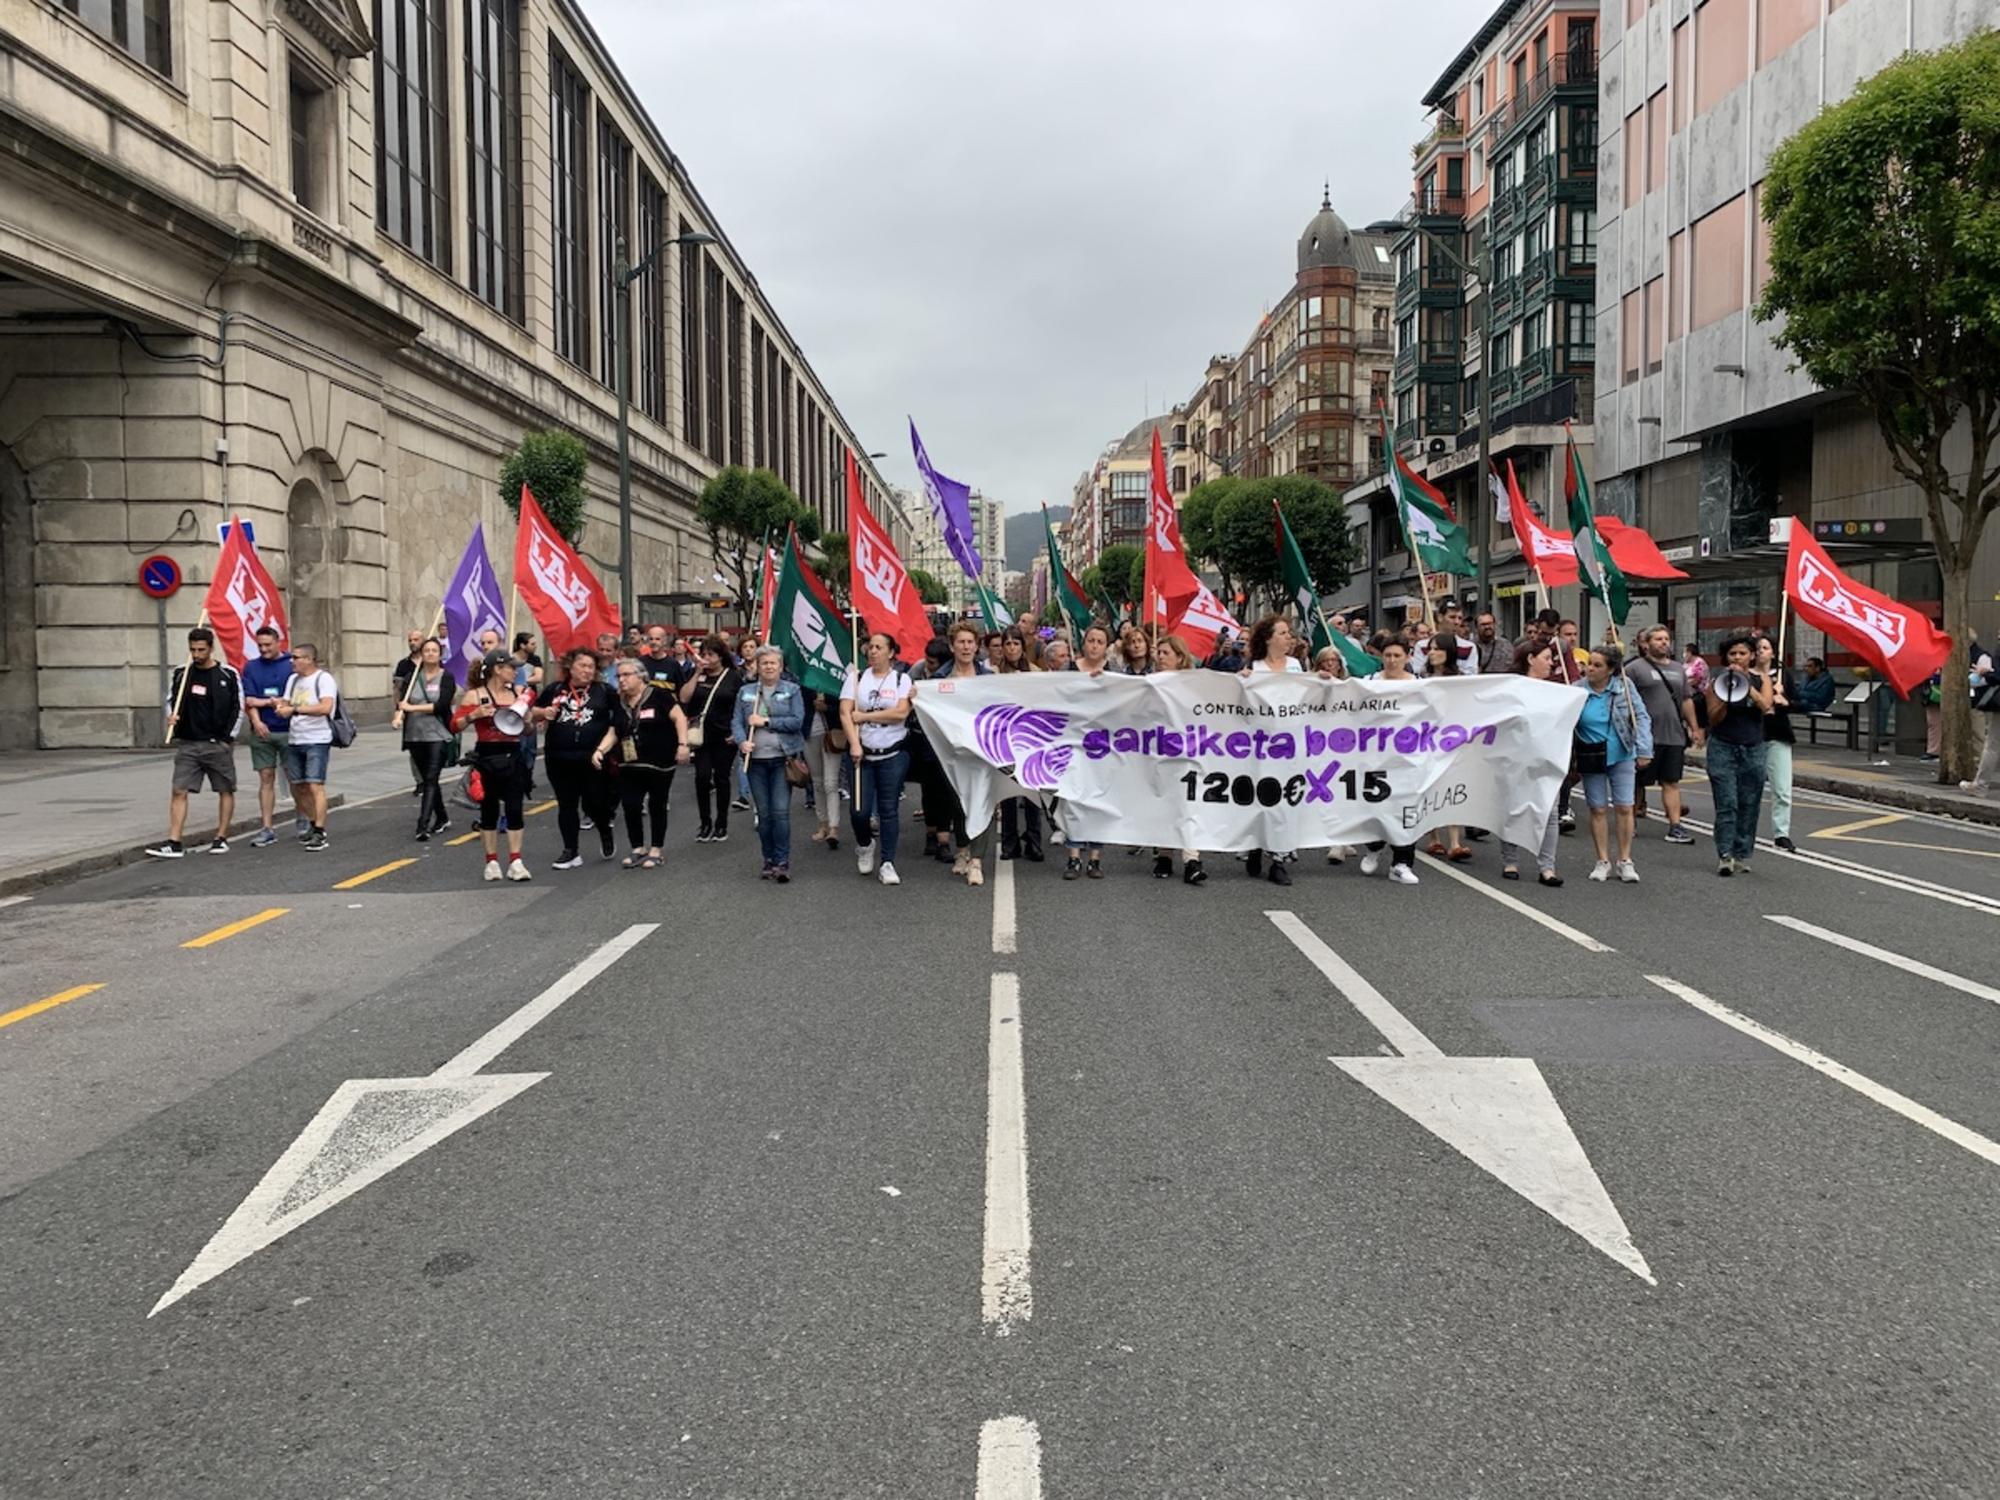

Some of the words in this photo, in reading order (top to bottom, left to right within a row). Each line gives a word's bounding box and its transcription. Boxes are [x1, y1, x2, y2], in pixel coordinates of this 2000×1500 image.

[1800, 559, 1896, 636] LAB
[1192, 702, 1255, 717] CONTRA
[1259, 705, 1276, 718] LA
[1331, 698, 1401, 713] SALARIAL
[1082, 724, 1296, 760] garbiketa
[1304, 721, 1498, 757] borrokan
